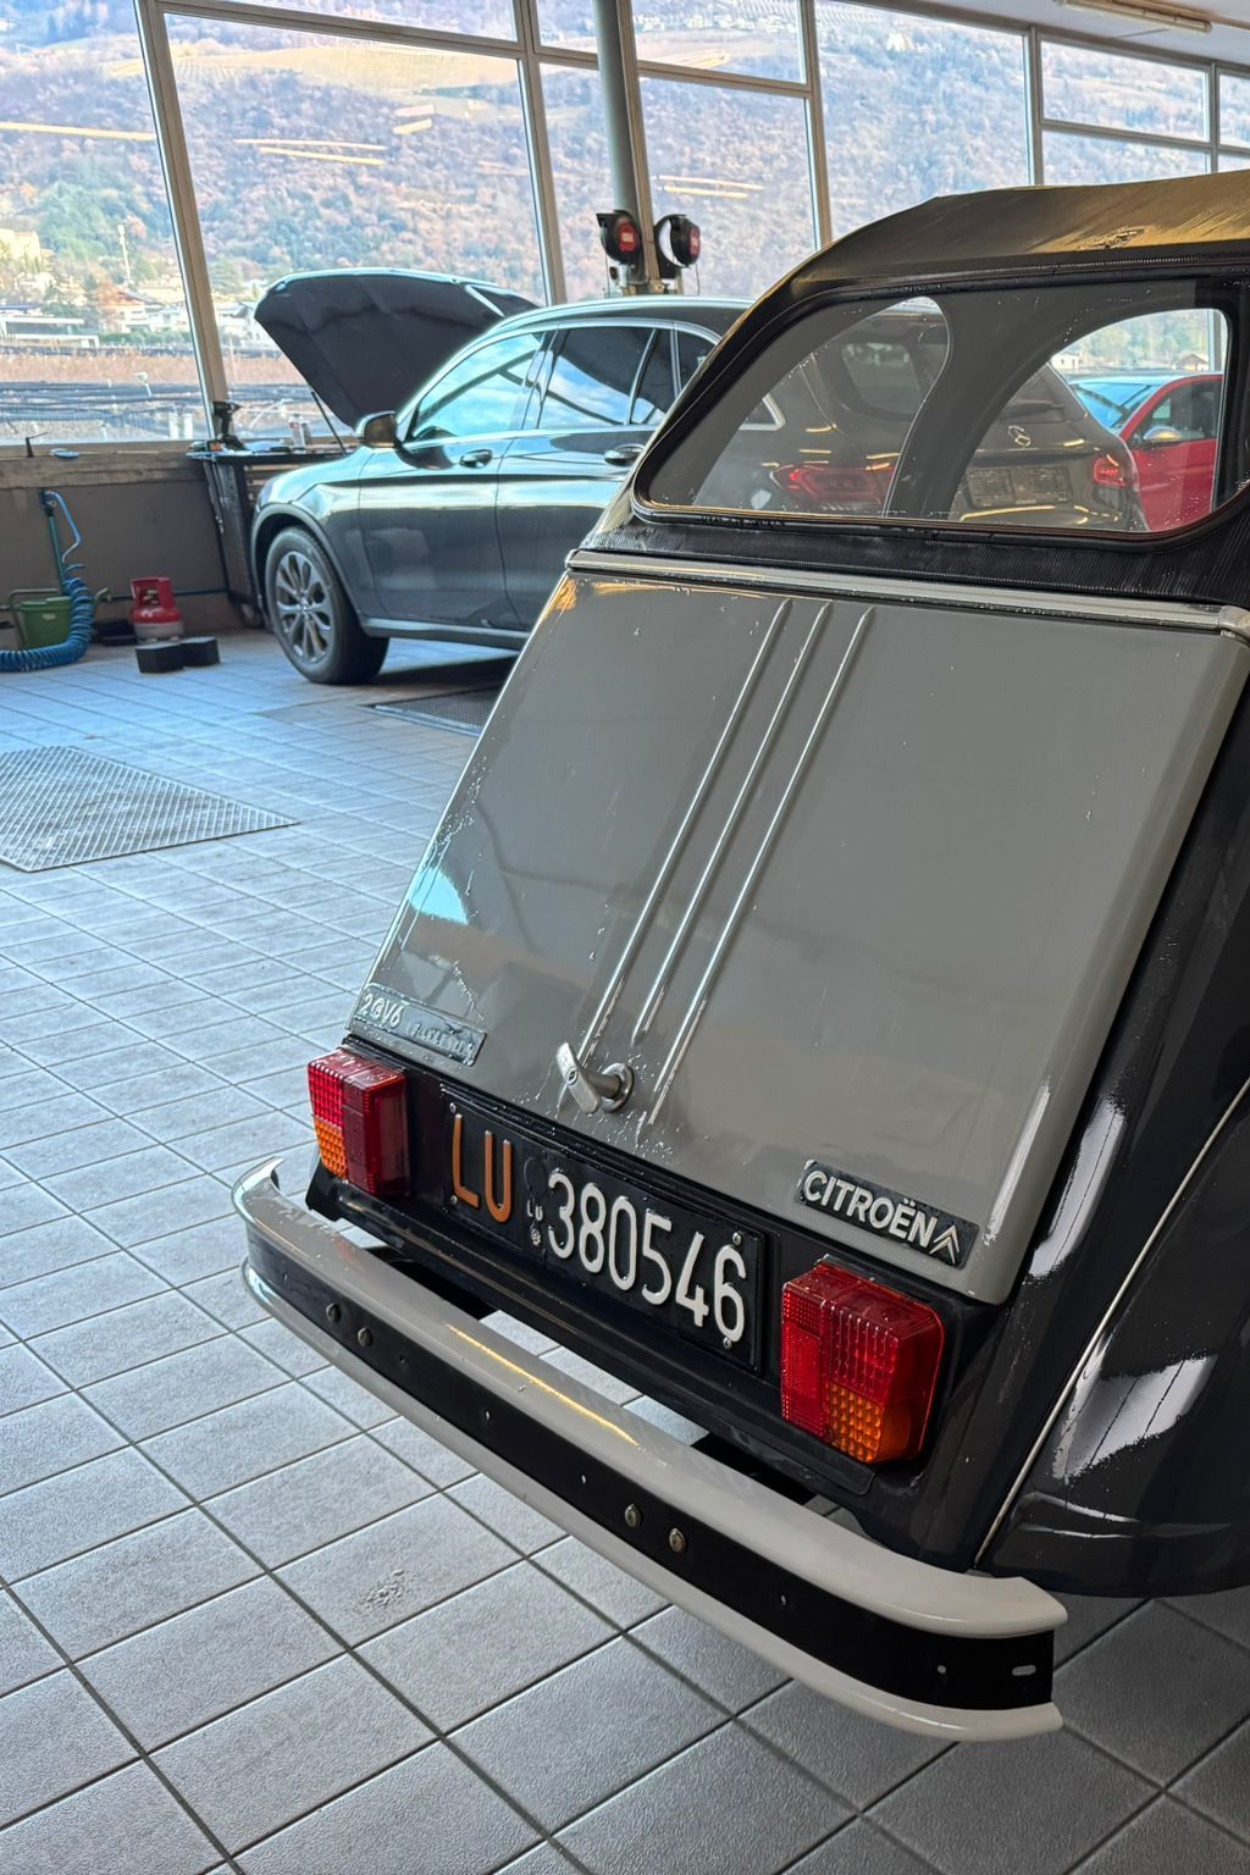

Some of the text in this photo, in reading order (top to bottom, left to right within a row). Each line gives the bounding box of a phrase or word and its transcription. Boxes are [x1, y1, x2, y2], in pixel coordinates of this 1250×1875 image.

[452, 1113, 747, 1343] LU 380546
[803, 1170, 938, 1248] CITROËN
